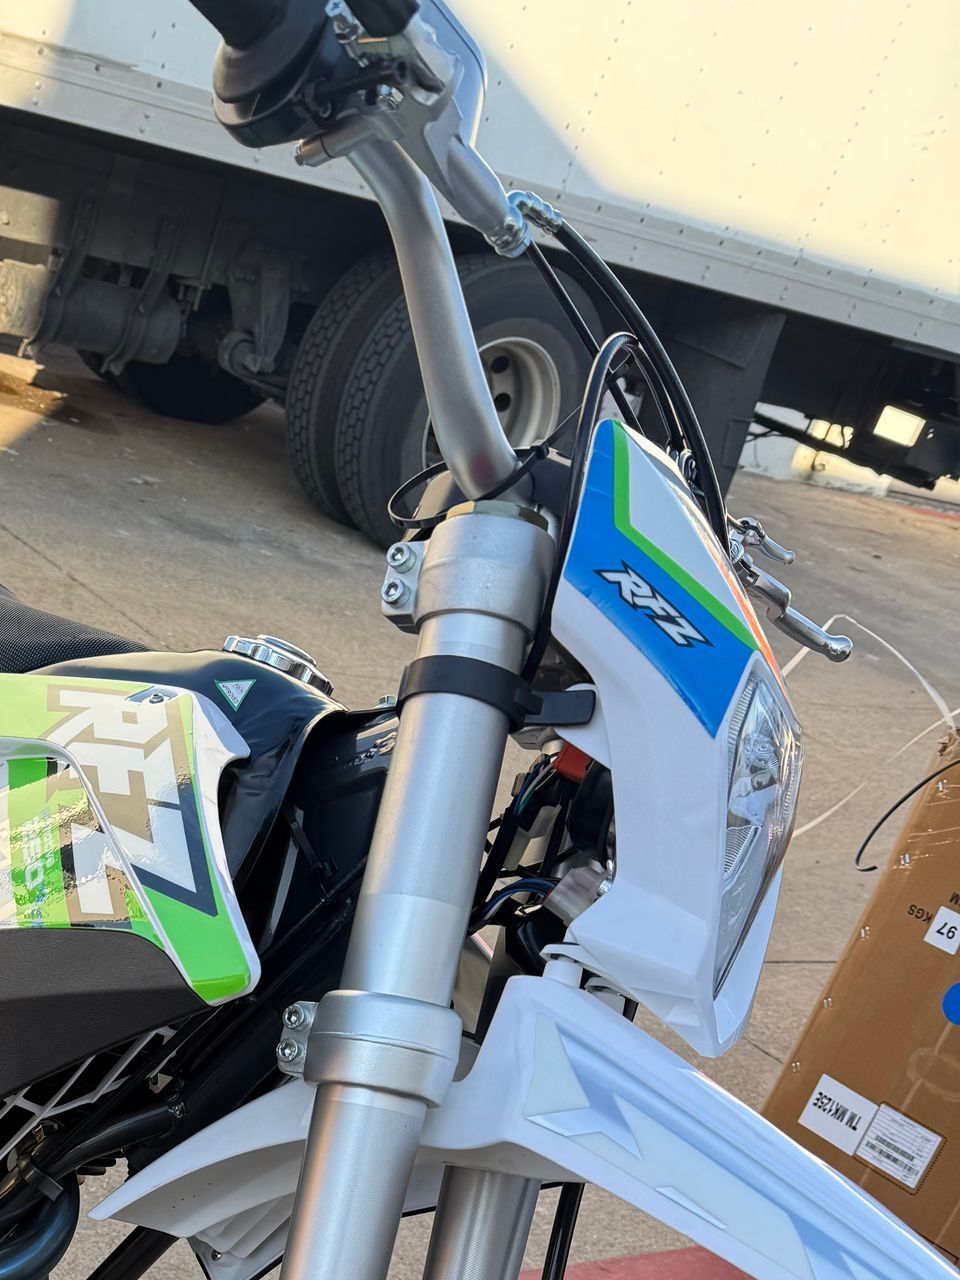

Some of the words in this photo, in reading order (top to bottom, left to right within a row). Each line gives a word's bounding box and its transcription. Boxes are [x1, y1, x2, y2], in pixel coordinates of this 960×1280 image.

[594, 560, 713, 647] RFZ
[907, 904, 934, 925] KGS
[935, 921, 958, 940] 97
[844, 1112, 862, 1131] TM
